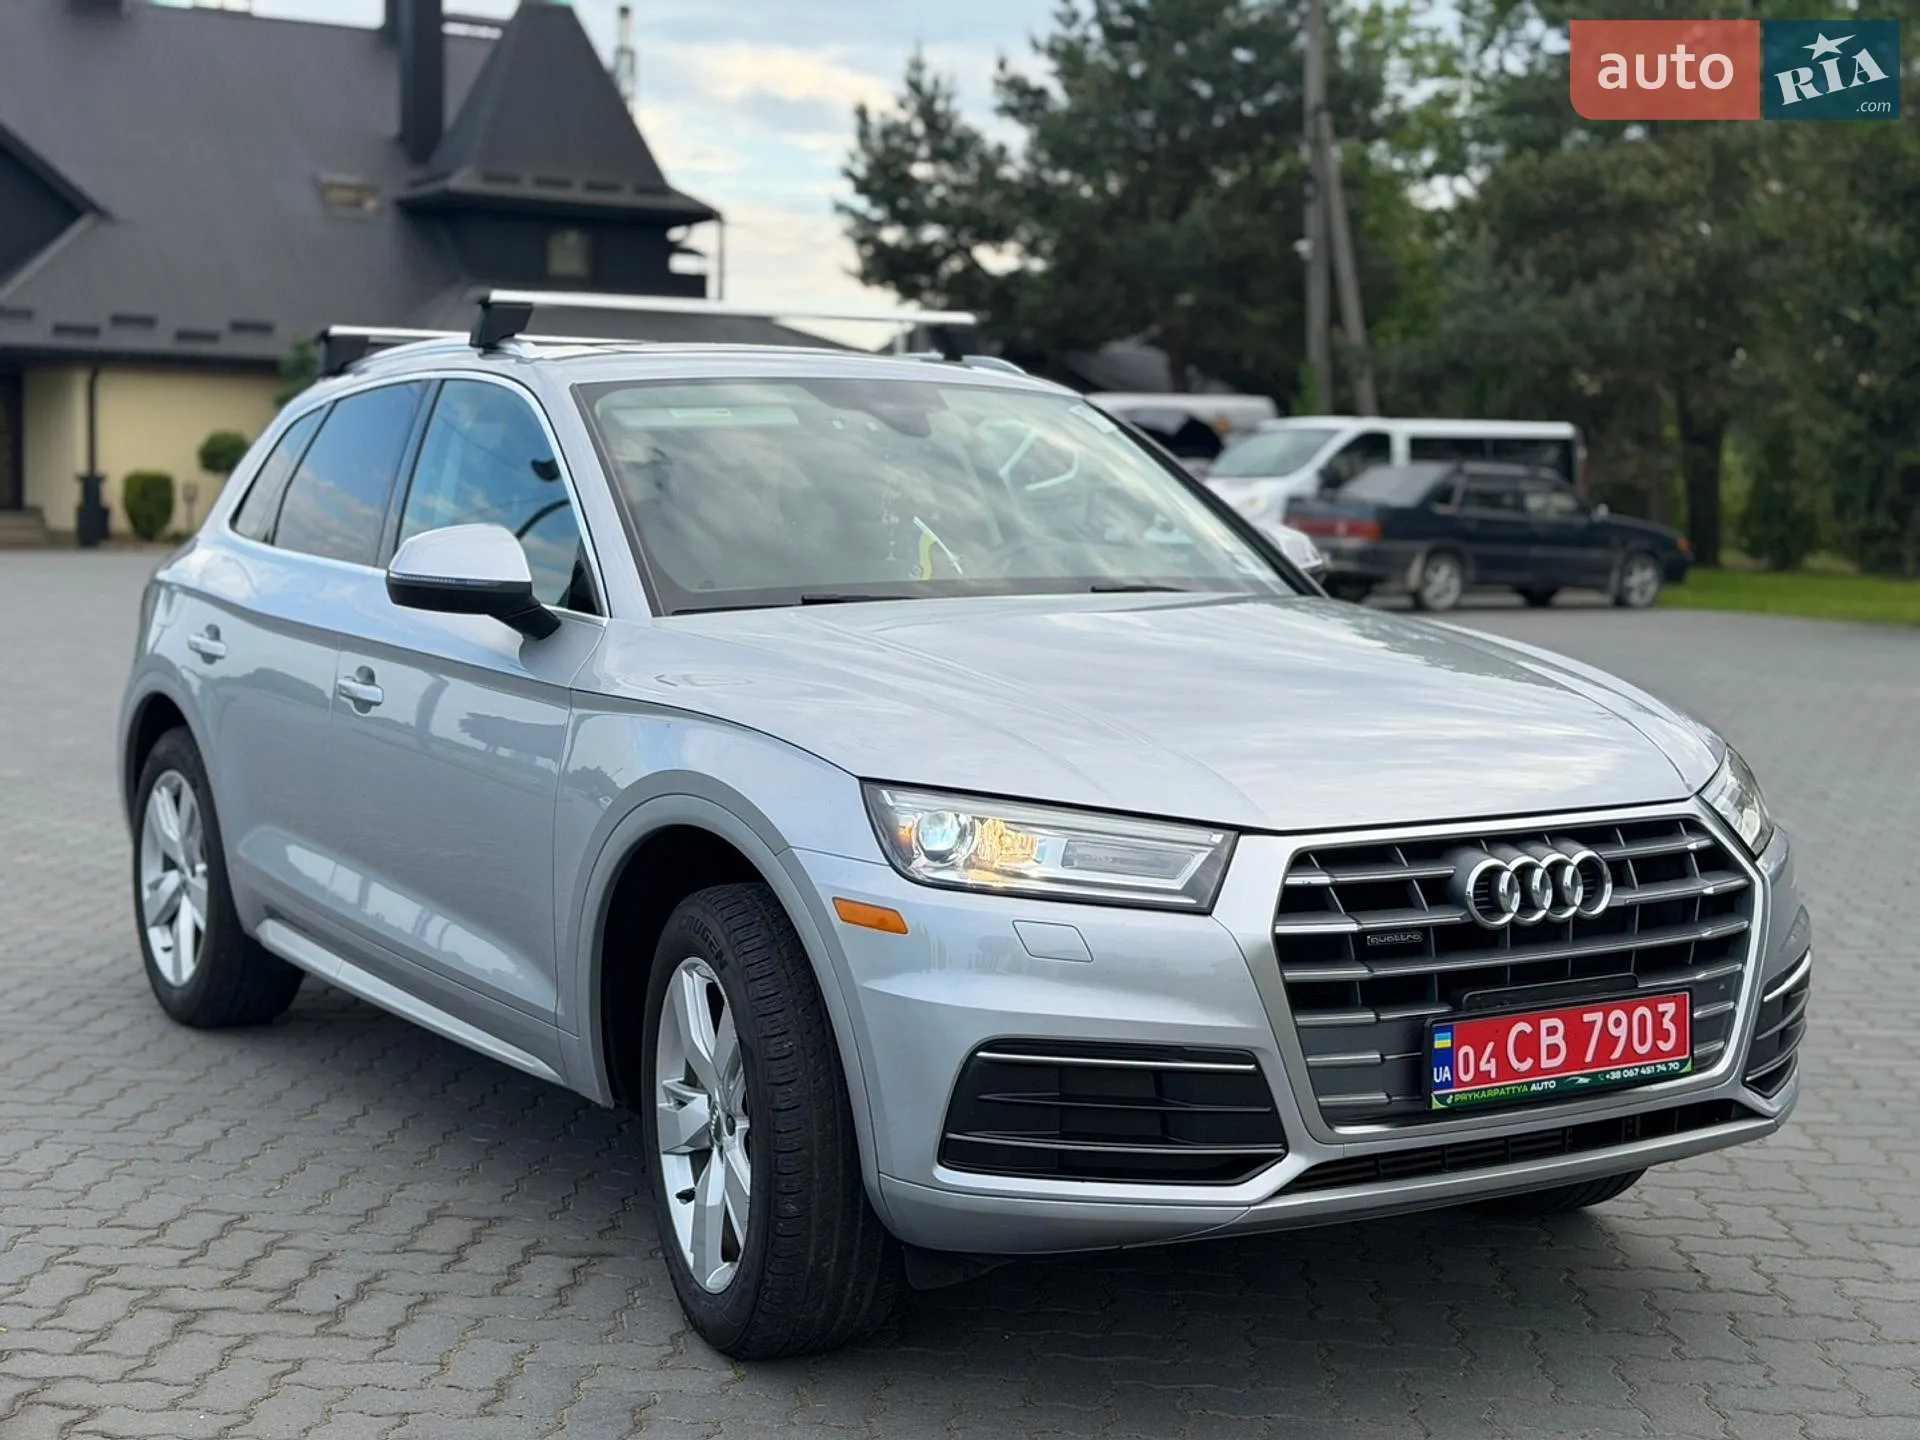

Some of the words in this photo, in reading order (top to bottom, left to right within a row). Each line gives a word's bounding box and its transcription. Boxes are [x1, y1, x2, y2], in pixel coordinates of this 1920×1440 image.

[1457, 1041, 1497, 1082] 04
[1507, 1018, 1567, 1072] CB
[1583, 1002, 1676, 1063] 7903
[1433, 1066, 1451, 1083] UA
[1668, 1061, 1680, 1071] 70
[1454, 1086, 1528, 1102] PRYKARPATTYA
[1530, 1080, 1556, 1092] AUTO
